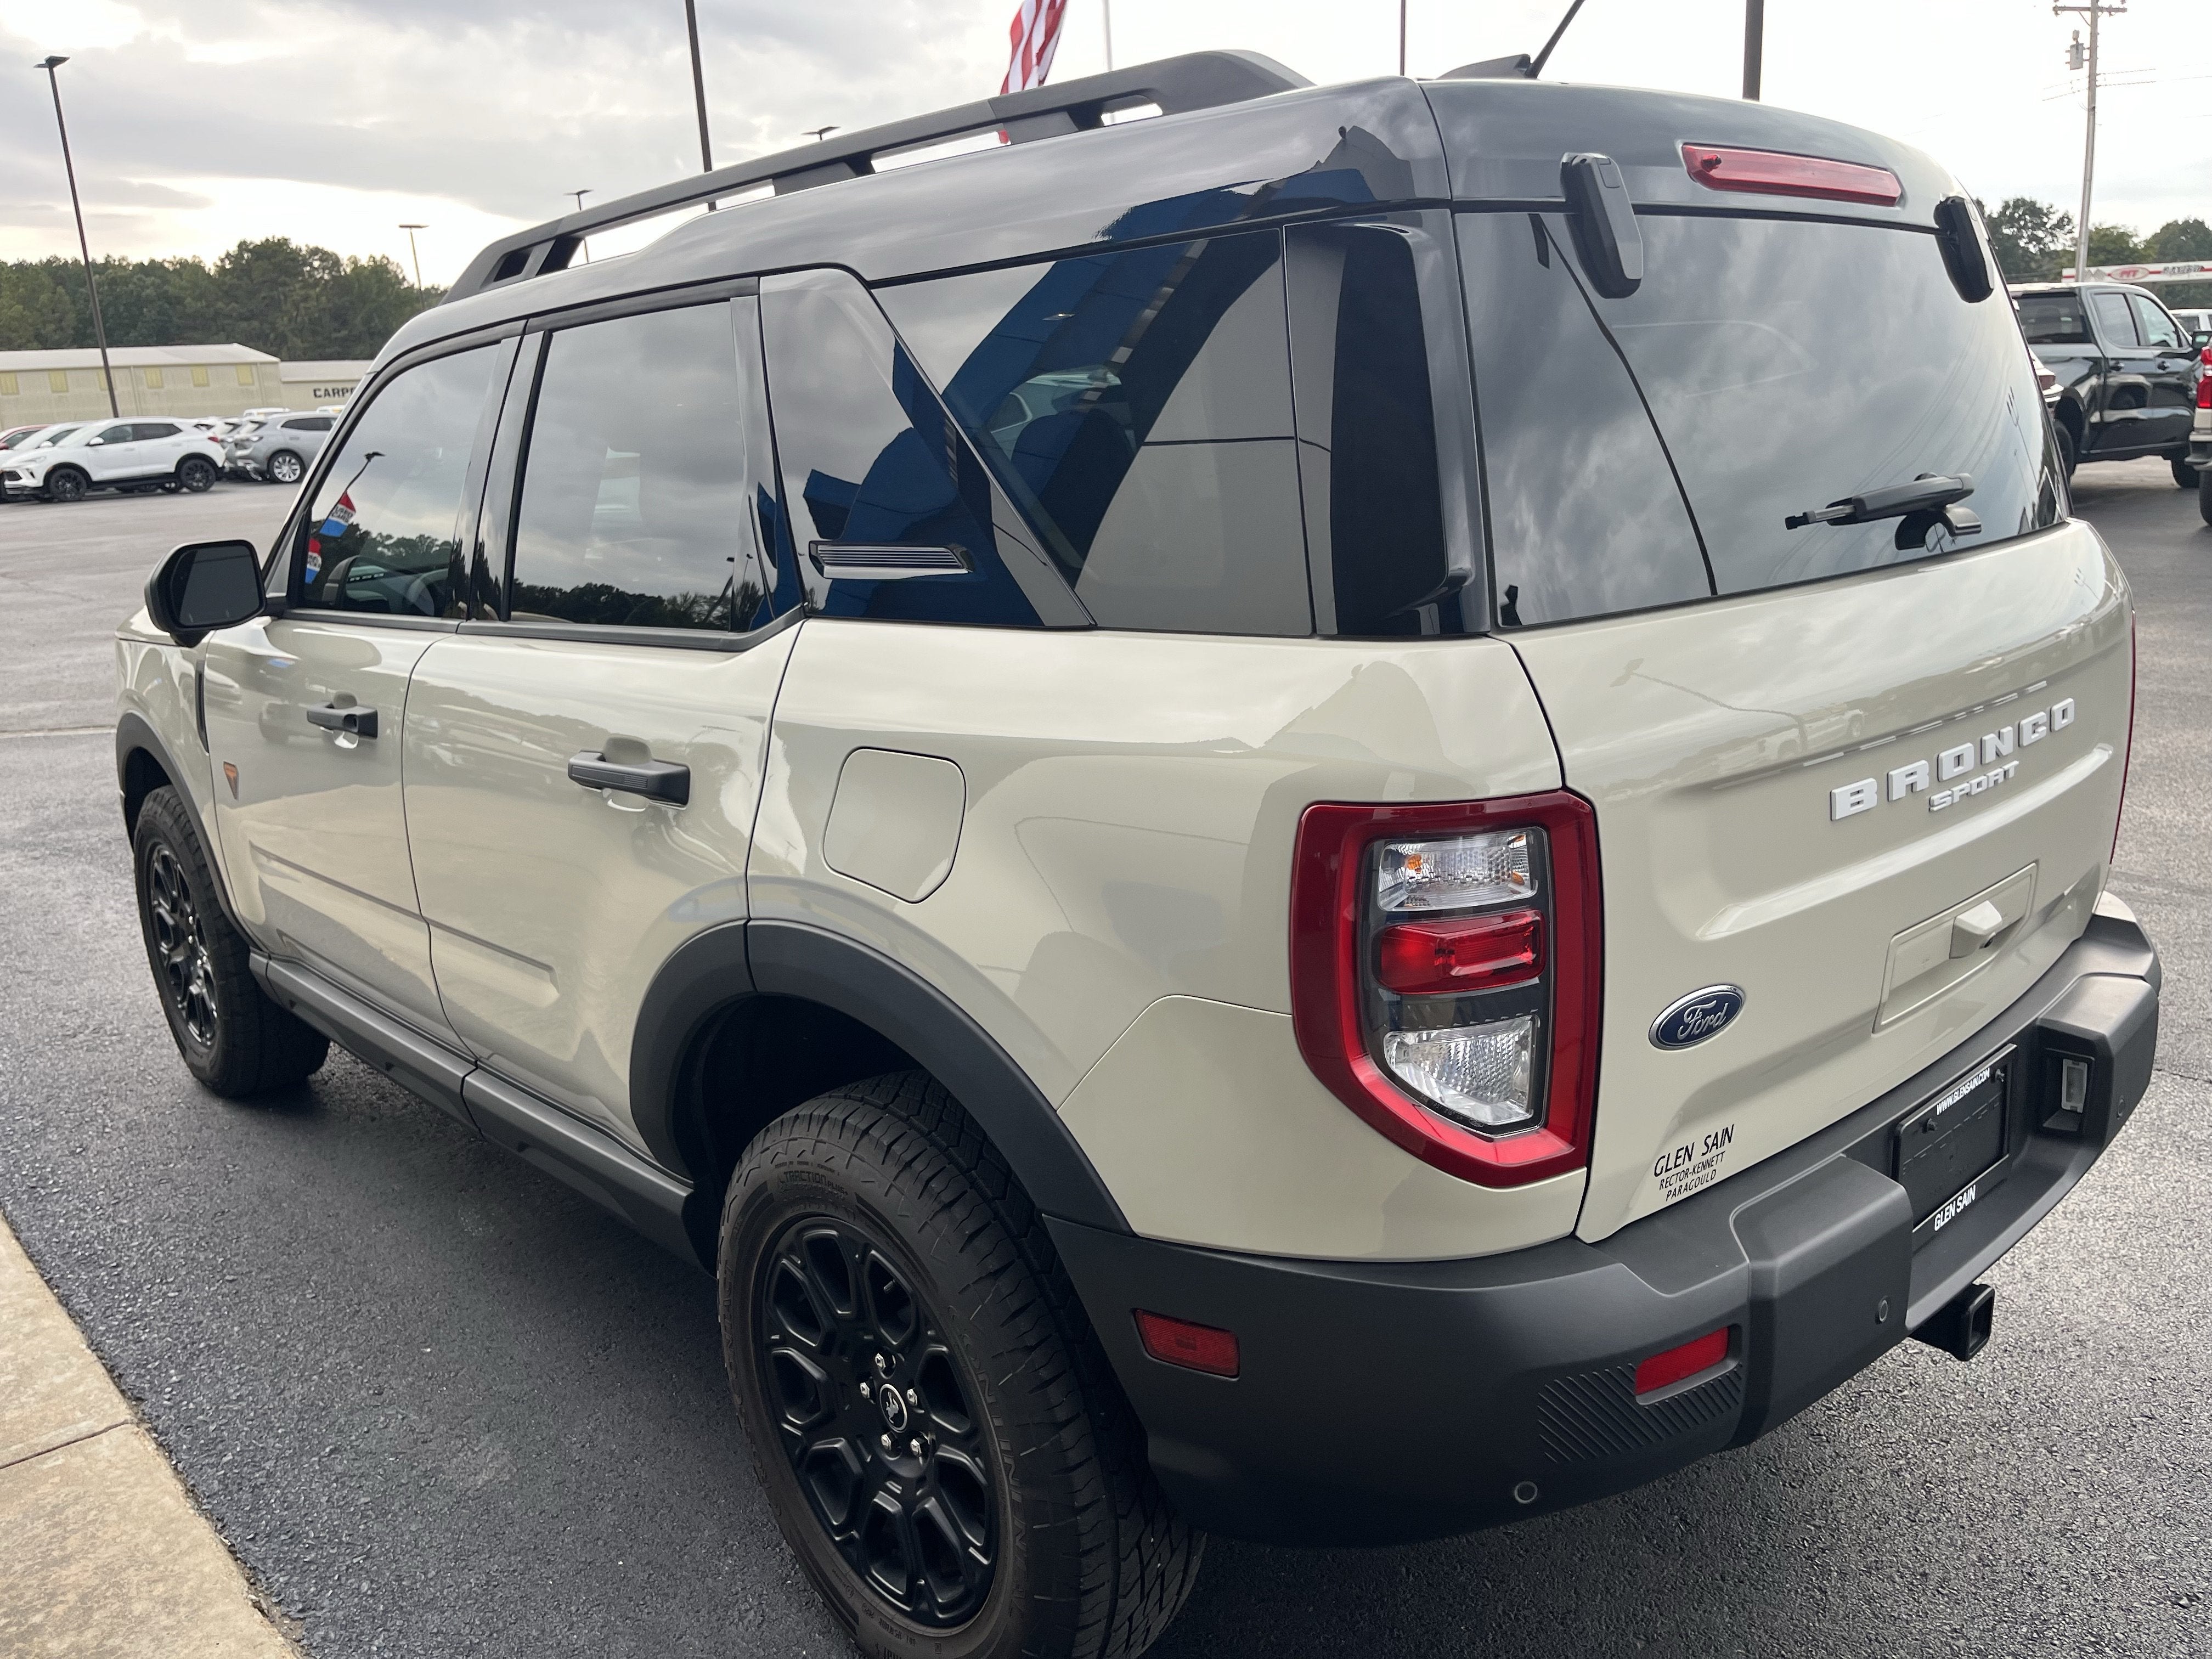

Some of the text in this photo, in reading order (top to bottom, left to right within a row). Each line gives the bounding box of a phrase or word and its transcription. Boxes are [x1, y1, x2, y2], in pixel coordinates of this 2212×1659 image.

[1830, 697, 2075, 821] BRONCO
[1929, 760, 2019, 812] SPORT
[1677, 1000, 1729, 1040] Ford
[1937, 1067, 1990, 1115] WWW.GLENSAIN.COM
[1654, 1124, 1735, 1177] GLEN SAIN
[1659, 1150, 1726, 1190] RECTOR-KENNETT
[1666, 1169, 1717, 1201] PARAGOULD
[1934, 1184, 1976, 1231] GLEN SAIN
